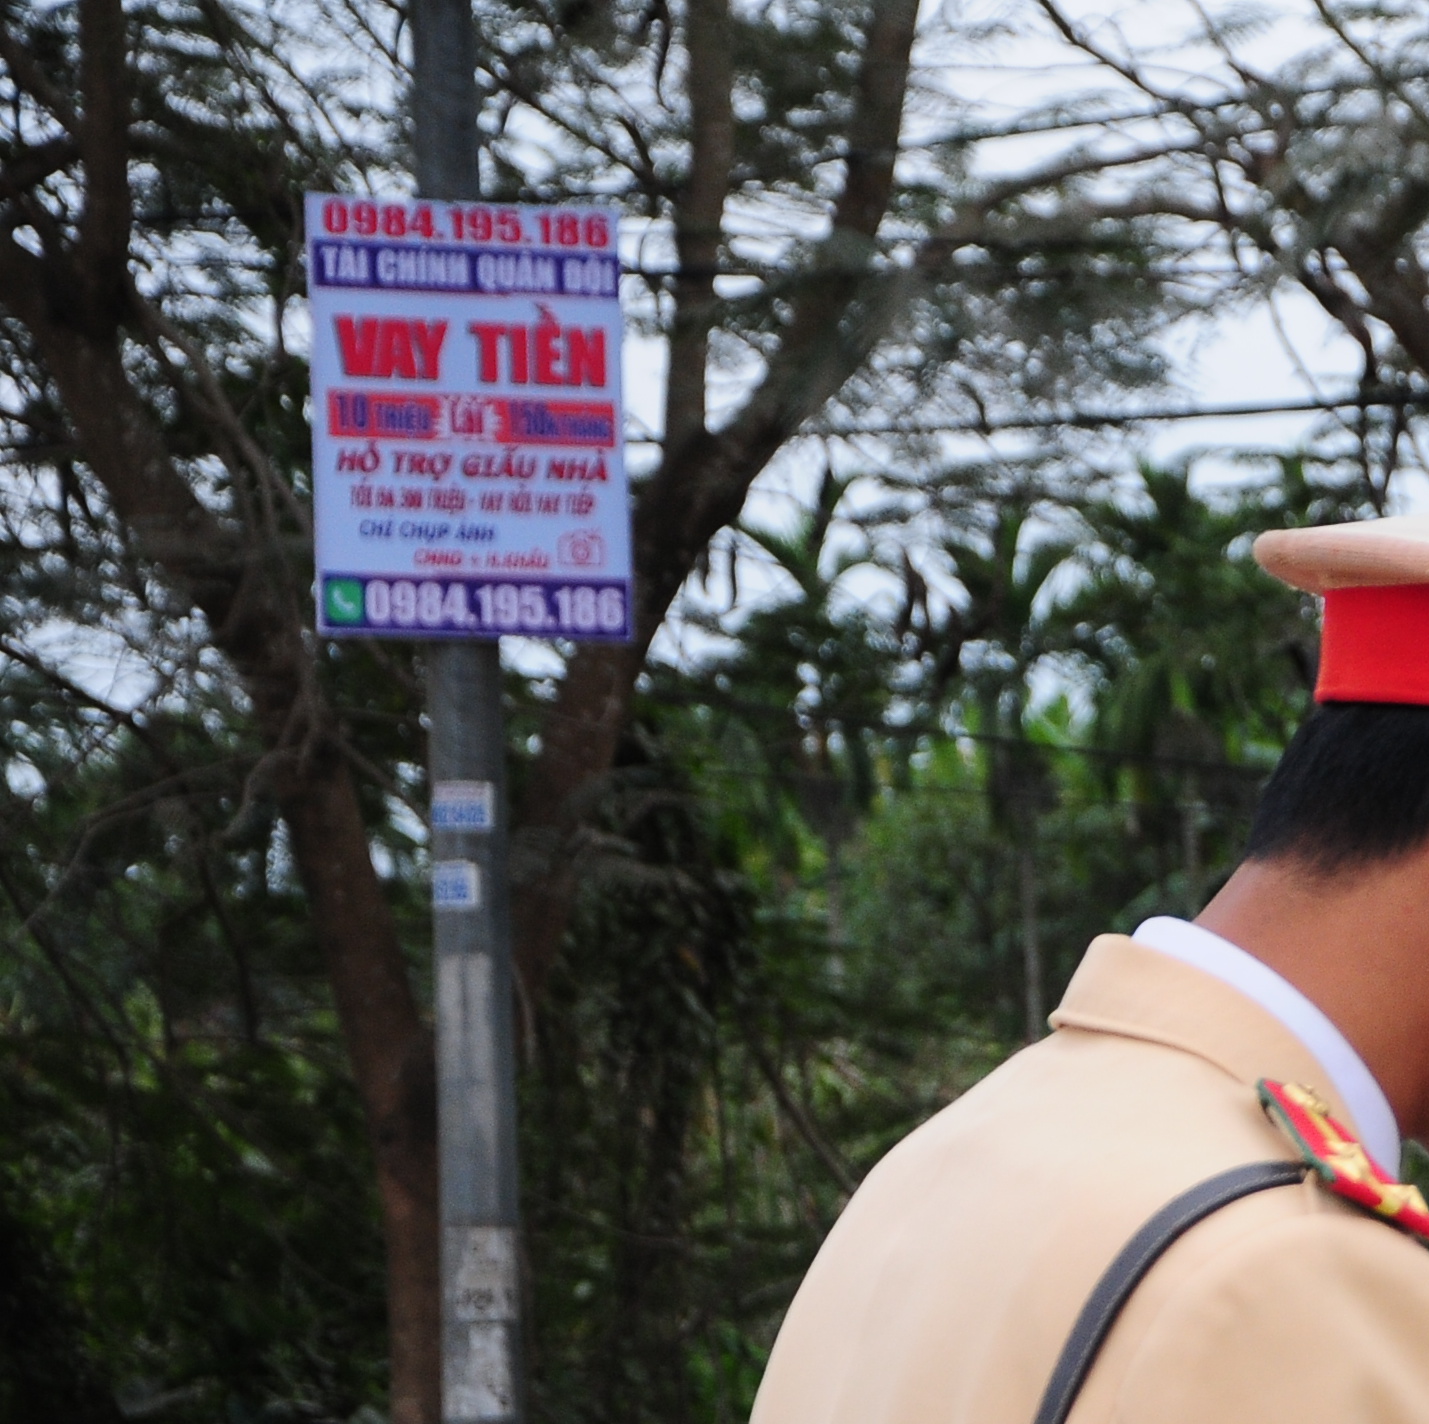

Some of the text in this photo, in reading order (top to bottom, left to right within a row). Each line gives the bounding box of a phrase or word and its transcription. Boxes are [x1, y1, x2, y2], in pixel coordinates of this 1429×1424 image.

[322, 201, 609, 248] 0984.195.186
[333, 302, 606, 387] VAY TIỀN
[364, 579, 625, 633] 0984.195.186
